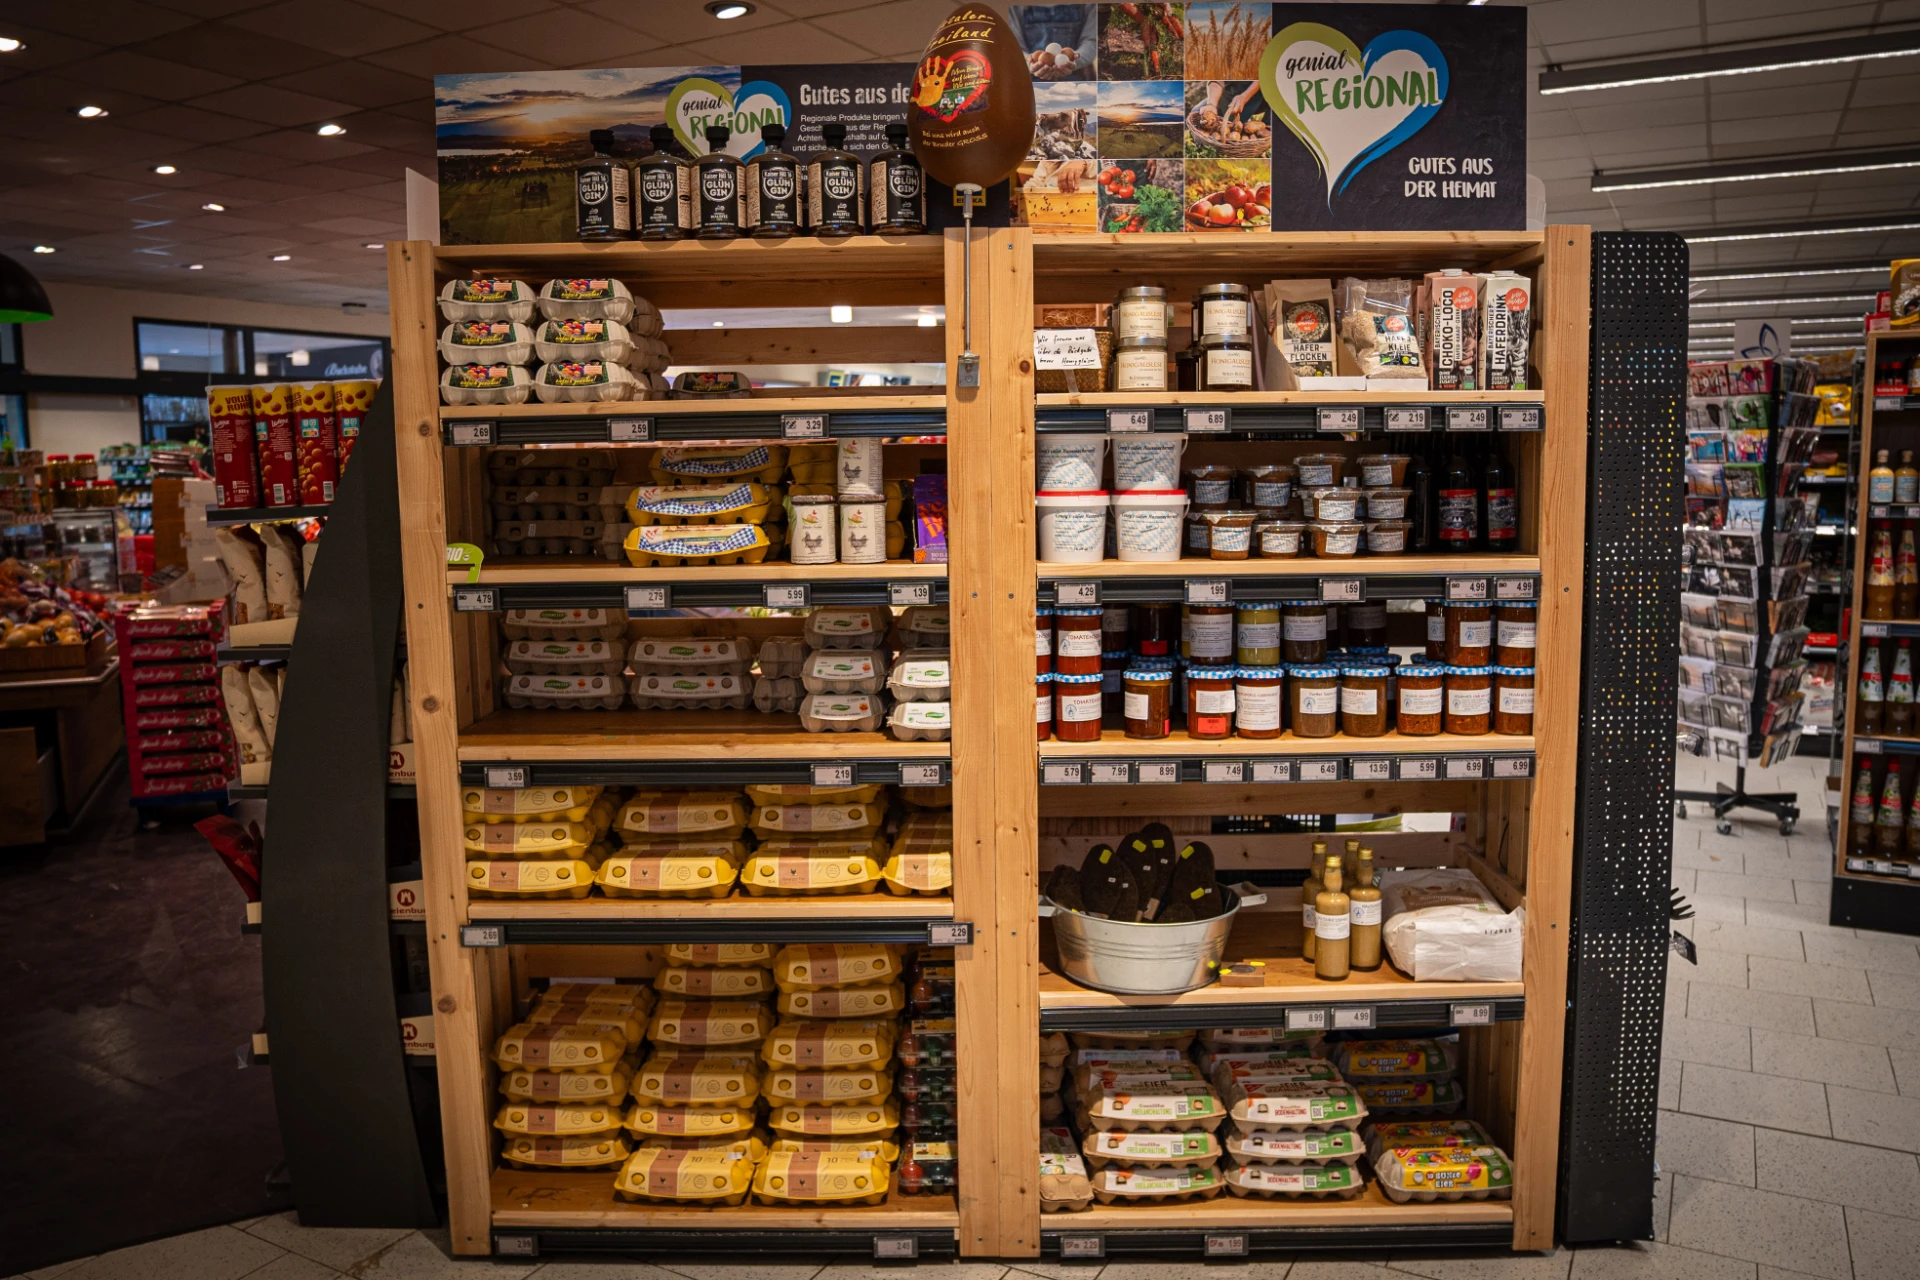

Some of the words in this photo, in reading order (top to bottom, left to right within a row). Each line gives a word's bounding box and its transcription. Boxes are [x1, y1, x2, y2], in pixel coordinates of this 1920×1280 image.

[1286, 49, 1348, 79] genial
[800, 83, 851, 105] Gutes
[854, 84, 887, 104] aus
[891, 82, 910, 103] de
[682, 97, 724, 116] genial
[801, 114, 837, 124] Regionale
[838, 113, 871, 122] Produkte
[872, 112, 900, 124] bringen
[860, 123, 871, 132] der
[797, 133, 823, 142] Achten
[956, 132, 989, 147] GROSS
[792, 143, 806, 152] und
[849, 142, 865, 151] sich
[866, 142, 880, 150] den
[1408, 157, 1457, 175] GUTES
[1462, 157, 1494, 175] AUS
[645, 179, 670, 190] GLÜH
[706, 178, 731, 189] GLÜH
[766, 177, 791, 187] GLÜH
[828, 177, 852, 187] GLÜH
[893, 175, 917, 186] GLÜH
[582, 182, 605, 192] GLÜH
[770, 186, 788, 195] GIN
[831, 186, 850, 194] GIN
[897, 185, 914, 194] GIN
[1404, 180, 1437, 198] DER
[1442, 180, 1497, 198] HEIMAT
[584, 191, 601, 200] GIN
[649, 189, 667, 198] GIN
[709, 188, 728, 197] GIN
[1442, 290, 1454, 367] CHOKO-LOCO
[1495, 294, 1507, 365] HAFERDRINK
[1290, 353, 1328, 361] FLOCKEN
[225, 394, 250, 404] VOLLE
[227, 402, 250, 411] ROHR
[1131, 415, 1147, 425] 6.49
[1208, 414, 1224, 424] 6.89
[1341, 413, 1357, 422] 2.49
[1408, 413, 1424, 422] 2.19
[1470, 413, 1485, 422] 2.49
[1522, 413, 1537, 422] 2.39
[631, 423, 647, 434] 2.59
[806, 419, 823, 431] 3.29
[473, 427, 489, 438] 2.69
[1078, 587, 1094, 597] 4.29
[1211, 585, 1224, 595] 1.99
[1345, 584, 1358, 594] 1.59
[1469, 582, 1485, 592] 4.99
[1516, 582, 1532, 592] 4.99
[648, 592, 663, 602] 2.79
[787, 590, 803, 600] 5.99
[914, 587, 928, 598] 1.39
[476, 595, 492, 604] 4.79
[1159, 766, 1175, 776] 8.99
[1226, 766, 1241, 775] 7.49
[1273, 765, 1289, 775] 7.99
[1320, 764, 1336, 774] 6.49
[1369, 763, 1388, 773] 13.99
[1420, 762, 1435, 772] 5.99
[1466, 762, 1482, 771] 6.99
[1512, 761, 1528, 771] 6.99
[389, 769, 417, 778] enbur
[835, 769, 850, 779] 2.19
[923, 768, 938, 778] 2.29
[1064, 767, 1080, 776] 5.79
[1111, 767, 1127, 776] 7.99
[507, 772, 523, 782] 3.59
[483, 931, 498, 941] 2.69
[951, 928, 967, 937] 2.29
[1308, 1013, 1323, 1022] 8.99
[1354, 1012, 1369, 1021] 4.99
[1473, 1008, 1488, 1018] 8.99
[402, 1041, 435, 1049] enburg
[1274, 1108, 1307, 1116] BODENHALTUNG
[1267, 1176, 1300, 1184] BODENHALTUNG
